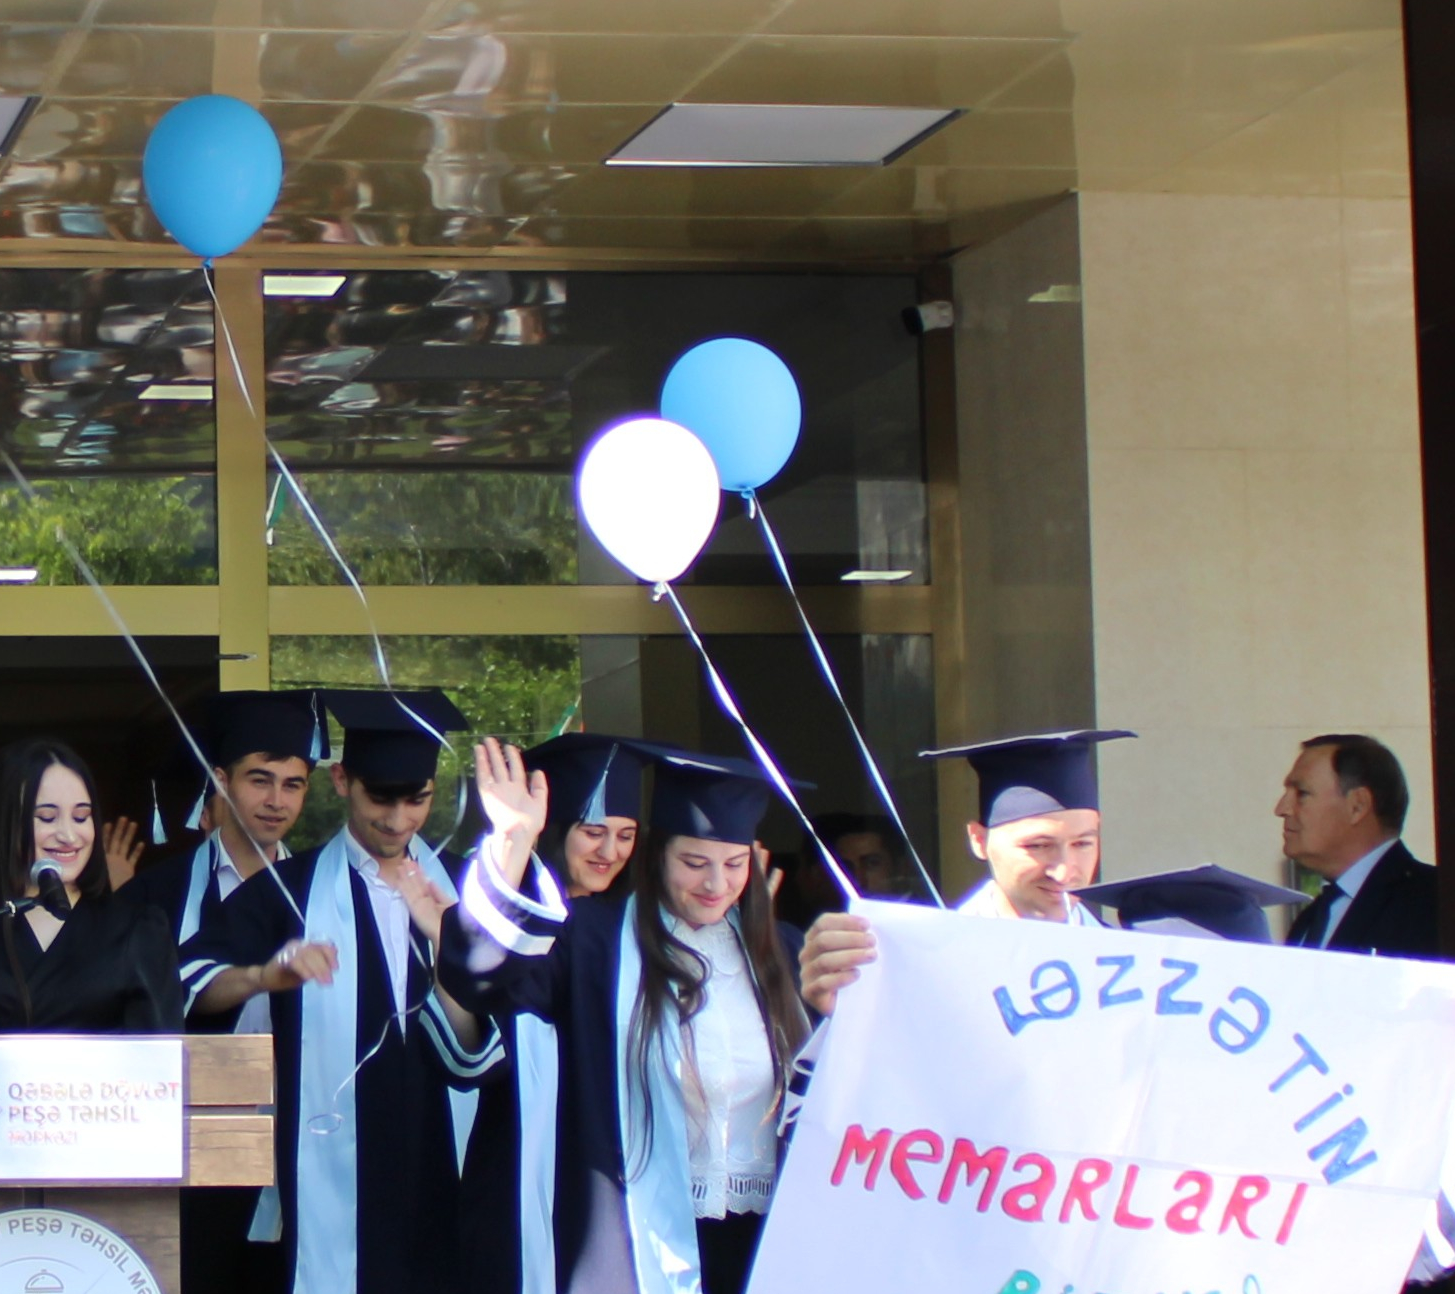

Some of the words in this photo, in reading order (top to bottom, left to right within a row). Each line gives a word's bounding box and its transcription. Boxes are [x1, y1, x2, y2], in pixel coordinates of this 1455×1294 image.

[8, 1105, 60, 1127] PEŞƏ
[8, 1217, 63, 1236] PEŞƏ
[70, 1222, 130, 1274] TƏHSİL
